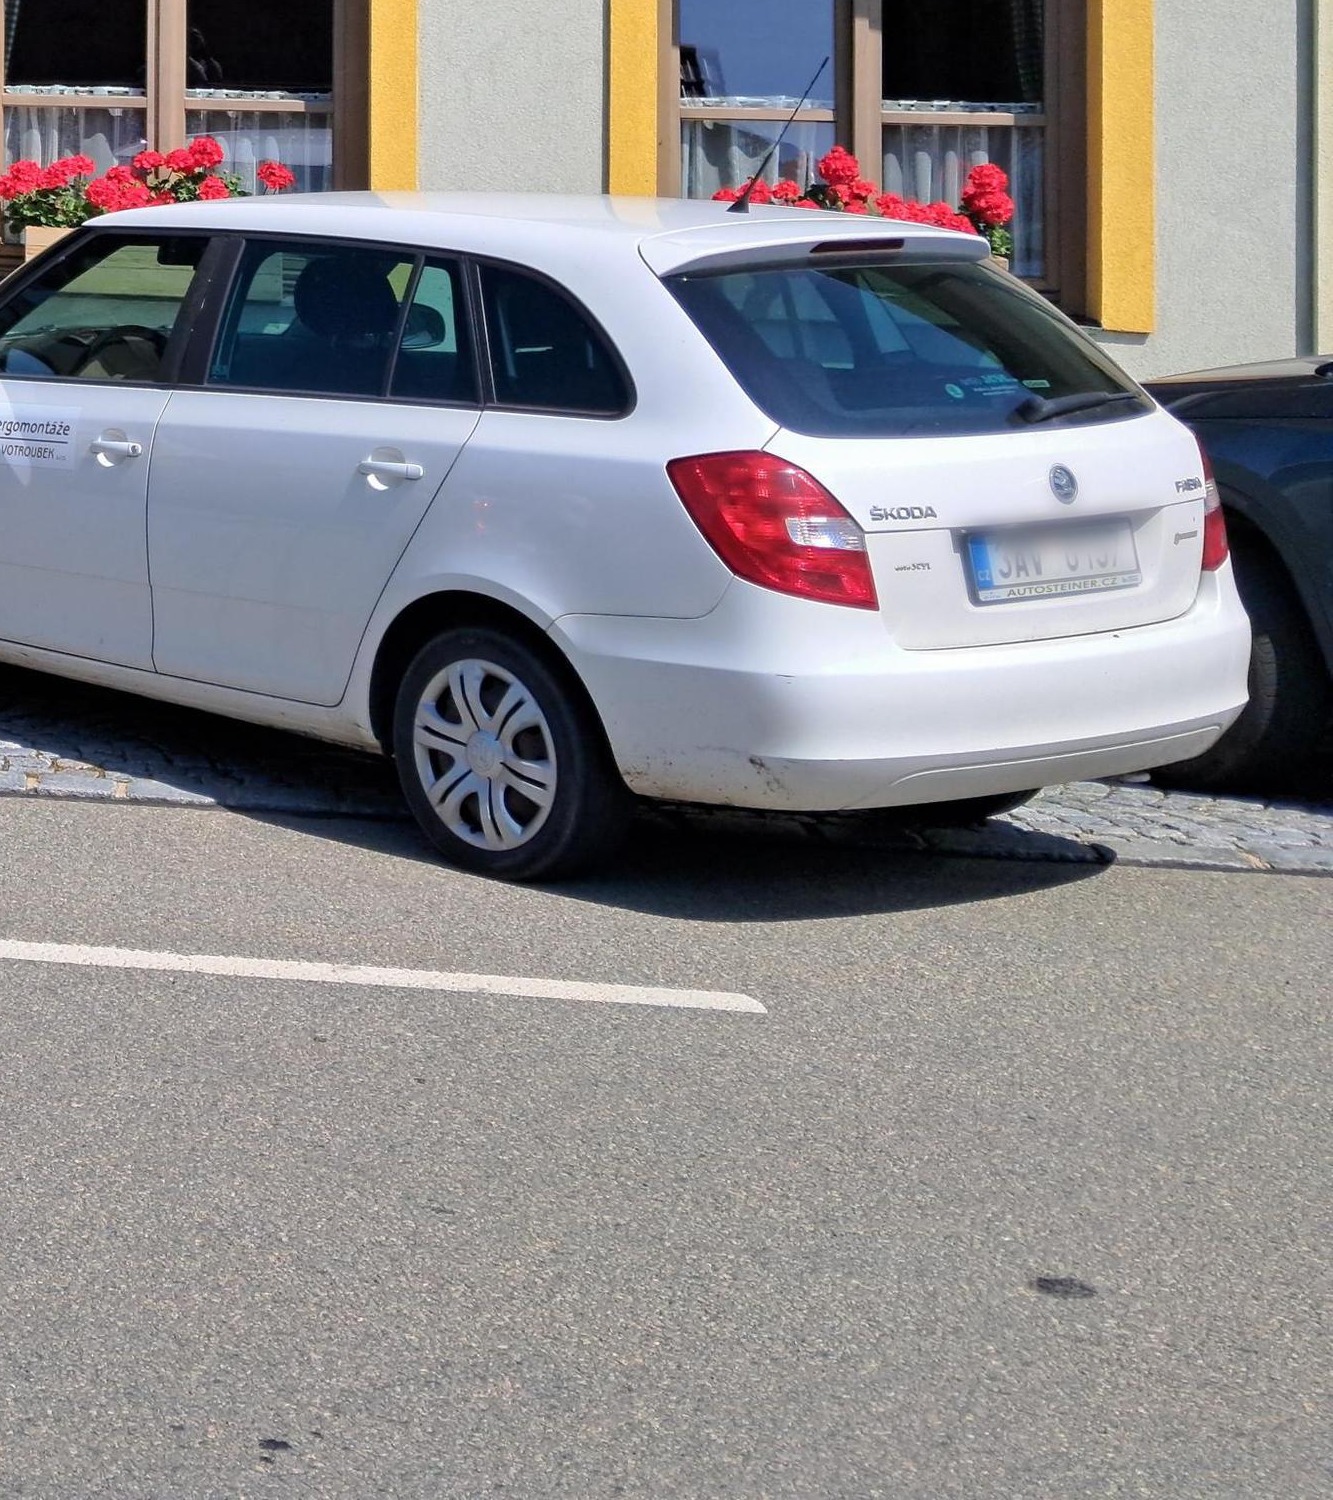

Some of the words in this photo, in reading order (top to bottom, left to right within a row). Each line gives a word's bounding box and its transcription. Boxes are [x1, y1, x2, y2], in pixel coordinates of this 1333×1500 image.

[2, 445, 54, 459] VOTROUBEK
[869, 505, 937, 521] ŠKODA
[1007, 577, 1118, 598] AUTOSTEINER.CZ
